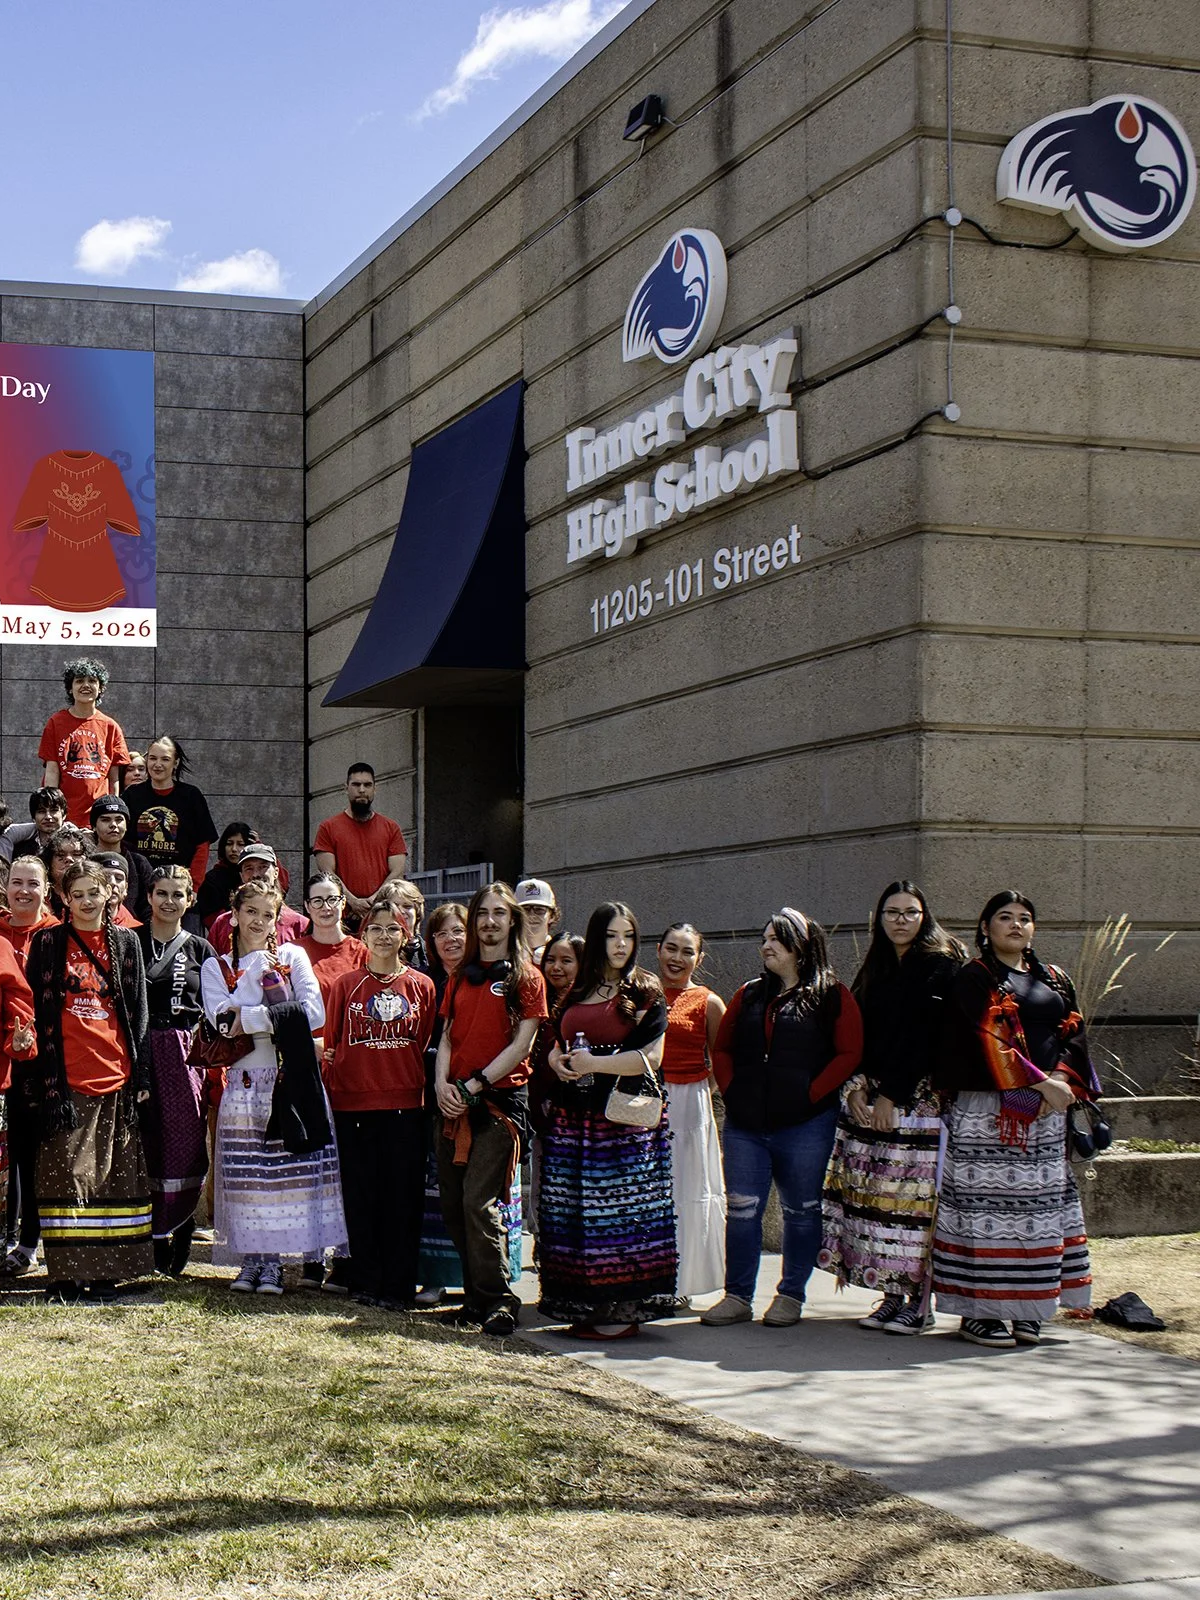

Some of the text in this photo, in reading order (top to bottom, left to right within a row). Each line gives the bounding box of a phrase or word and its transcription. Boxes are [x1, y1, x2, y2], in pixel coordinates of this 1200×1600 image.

[0, 375, 51, 404] Day
[566, 338, 798, 493] Inner City
[566, 409, 800, 564] High School
[590, 524, 802, 634] 11205-101 Street
[2, 616, 152, 640] May 5, 2026
[138, 840, 176, 850] NO MORE
[70, 949, 109, 960] STEN
[350, 1002, 364, 1010] 19
